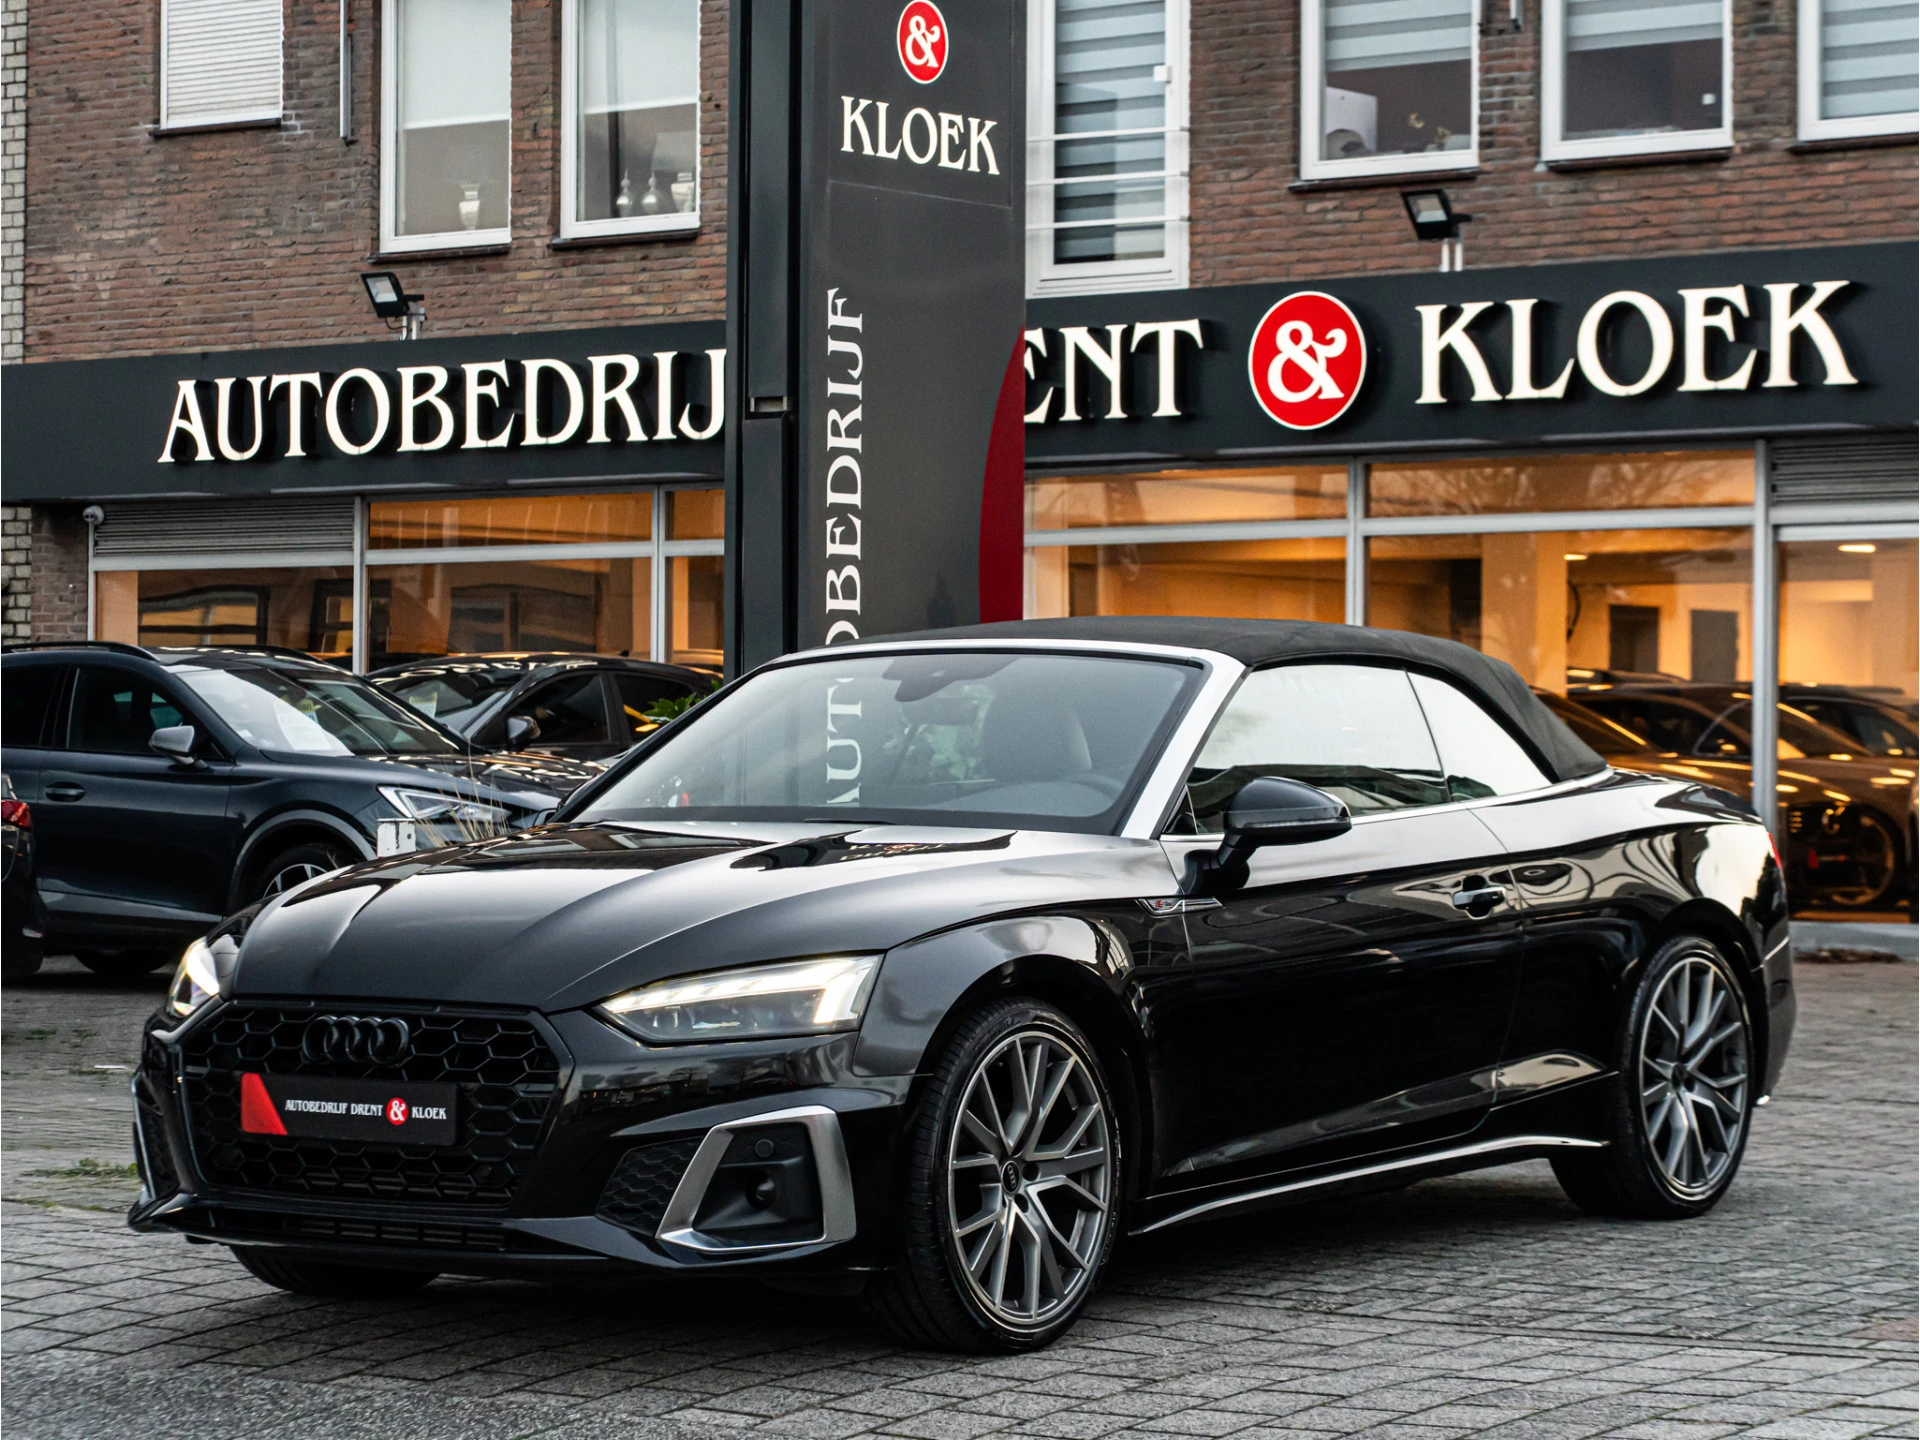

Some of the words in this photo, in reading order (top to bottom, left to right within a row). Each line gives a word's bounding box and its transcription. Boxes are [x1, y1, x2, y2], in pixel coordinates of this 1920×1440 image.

[906, 15, 941, 68] &
[841, 95, 1000, 176] KLOEK
[1267, 320, 1348, 403] &
[1415, 280, 1859, 405] KLOEK
[284, 1099, 348, 1115] AUTOBEDRIJF
[350, 1103, 383, 1117] DRENT
[390, 1100, 405, 1121] &
[411, 1106, 447, 1120] KLOEK
